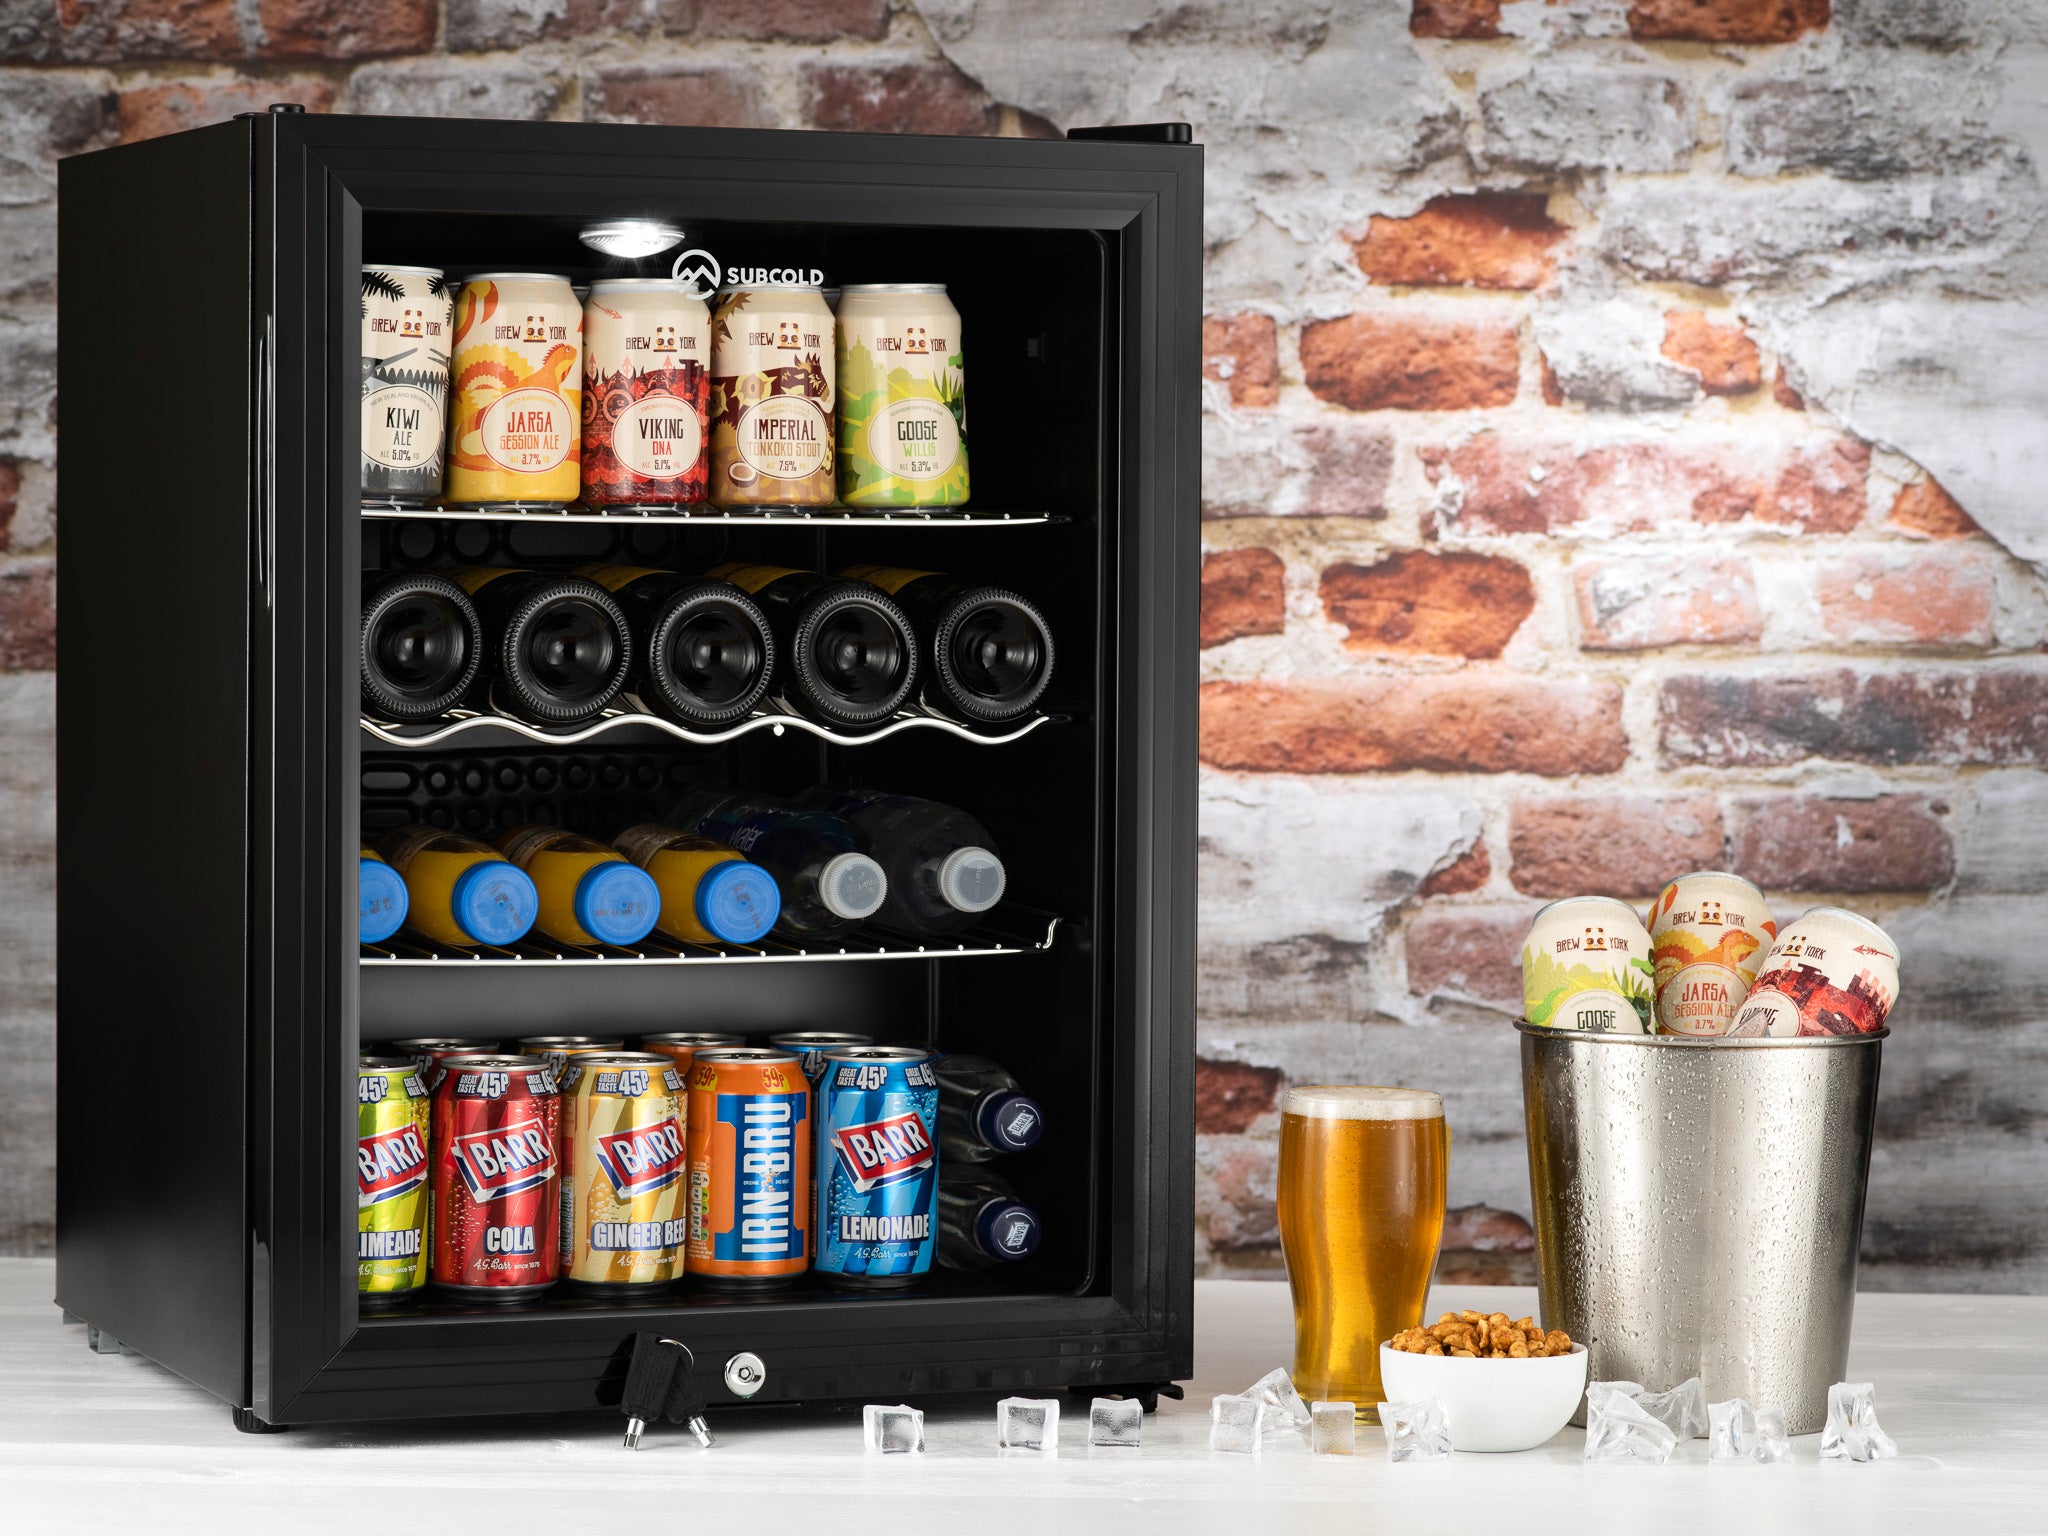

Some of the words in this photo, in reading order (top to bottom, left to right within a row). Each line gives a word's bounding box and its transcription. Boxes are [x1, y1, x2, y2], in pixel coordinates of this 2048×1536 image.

[727, 267, 824, 286] SUBCOLD
[371, 318, 398, 334] BREW
[425, 321, 441, 336] YORK
[495, 326, 521, 340] BREW
[549, 326, 567, 340] YORK
[625, 337, 651, 350] BREW
[679, 336, 696, 350] YORK
[749, 333, 775, 346] BREW
[804, 333, 821, 348] YORK
[876, 337, 902, 351] BREW
[930, 338, 947, 352] YORK
[386, 407, 420, 430] KIWI
[507, 411, 553, 433] JARSA
[639, 418, 684, 439] VIKING
[754, 419, 816, 441] IMPERIAL
[897, 420, 938, 441] GOOSE
[393, 431, 412, 446] ALE
[500, 434, 539, 450] SESSION
[543, 434, 560, 450] ALE
[392, 449, 412, 461] 5.0%
[652, 441, 672, 456] DNA
[747, 441, 792, 457] TONKOKO
[796, 442, 821, 458] STOUT
[902, 442, 937, 457] WILLIS
[521, 453, 541, 465] 3.7%
[654, 459, 671, 470] 5.1%
[779, 460, 798, 472] 7.5%
[911, 461, 931, 472] 5.3%
[1672, 911, 1697, 926] BREW
[1725, 912, 1745, 928] YORK
[1556, 937, 1580, 953] BREW
[1609, 937, 1629, 952] YORK
[1804, 945, 1827, 961] YORK
[1682, 982, 1728, 1003] JARSA
[1577, 1010, 1617, 1029] GOOSE
[1674, 1003, 1713, 1019] SESSION
[1717, 1003, 1735, 1019] ALE
[1695, 1019, 1715, 1030] 3.7%
[460, 1074, 479, 1085] GREAT
[599, 1073, 619, 1083] GREAT
[839, 1068, 857, 1077] GREAT
[856, 1066, 888, 1090] 45P
[359, 1077, 388, 1101] 45P
[457, 1084, 476, 1094] TASTE
[477, 1072, 509, 1098] 45P
[597, 1082, 617, 1093] TASTE
[619, 1070, 649, 1096] 45P
[837, 1077, 855, 1087] TASTE
[1011, 1114, 1031, 1132] BARR
[611, 1125, 684, 1176] BARR
[849, 1120, 929, 1169] BARR
[359, 1131, 425, 1183] BARR
[469, 1129, 551, 1179] BARR
[593, 1222, 662, 1249] GINGER
[842, 1213, 930, 1241] LEMONADE
[1010, 1225, 1026, 1245] BARR
[359, 1228, 421, 1257] IMEADE
[486, 1226, 534, 1252] COLA
[893, 1250, 907, 1258] since
